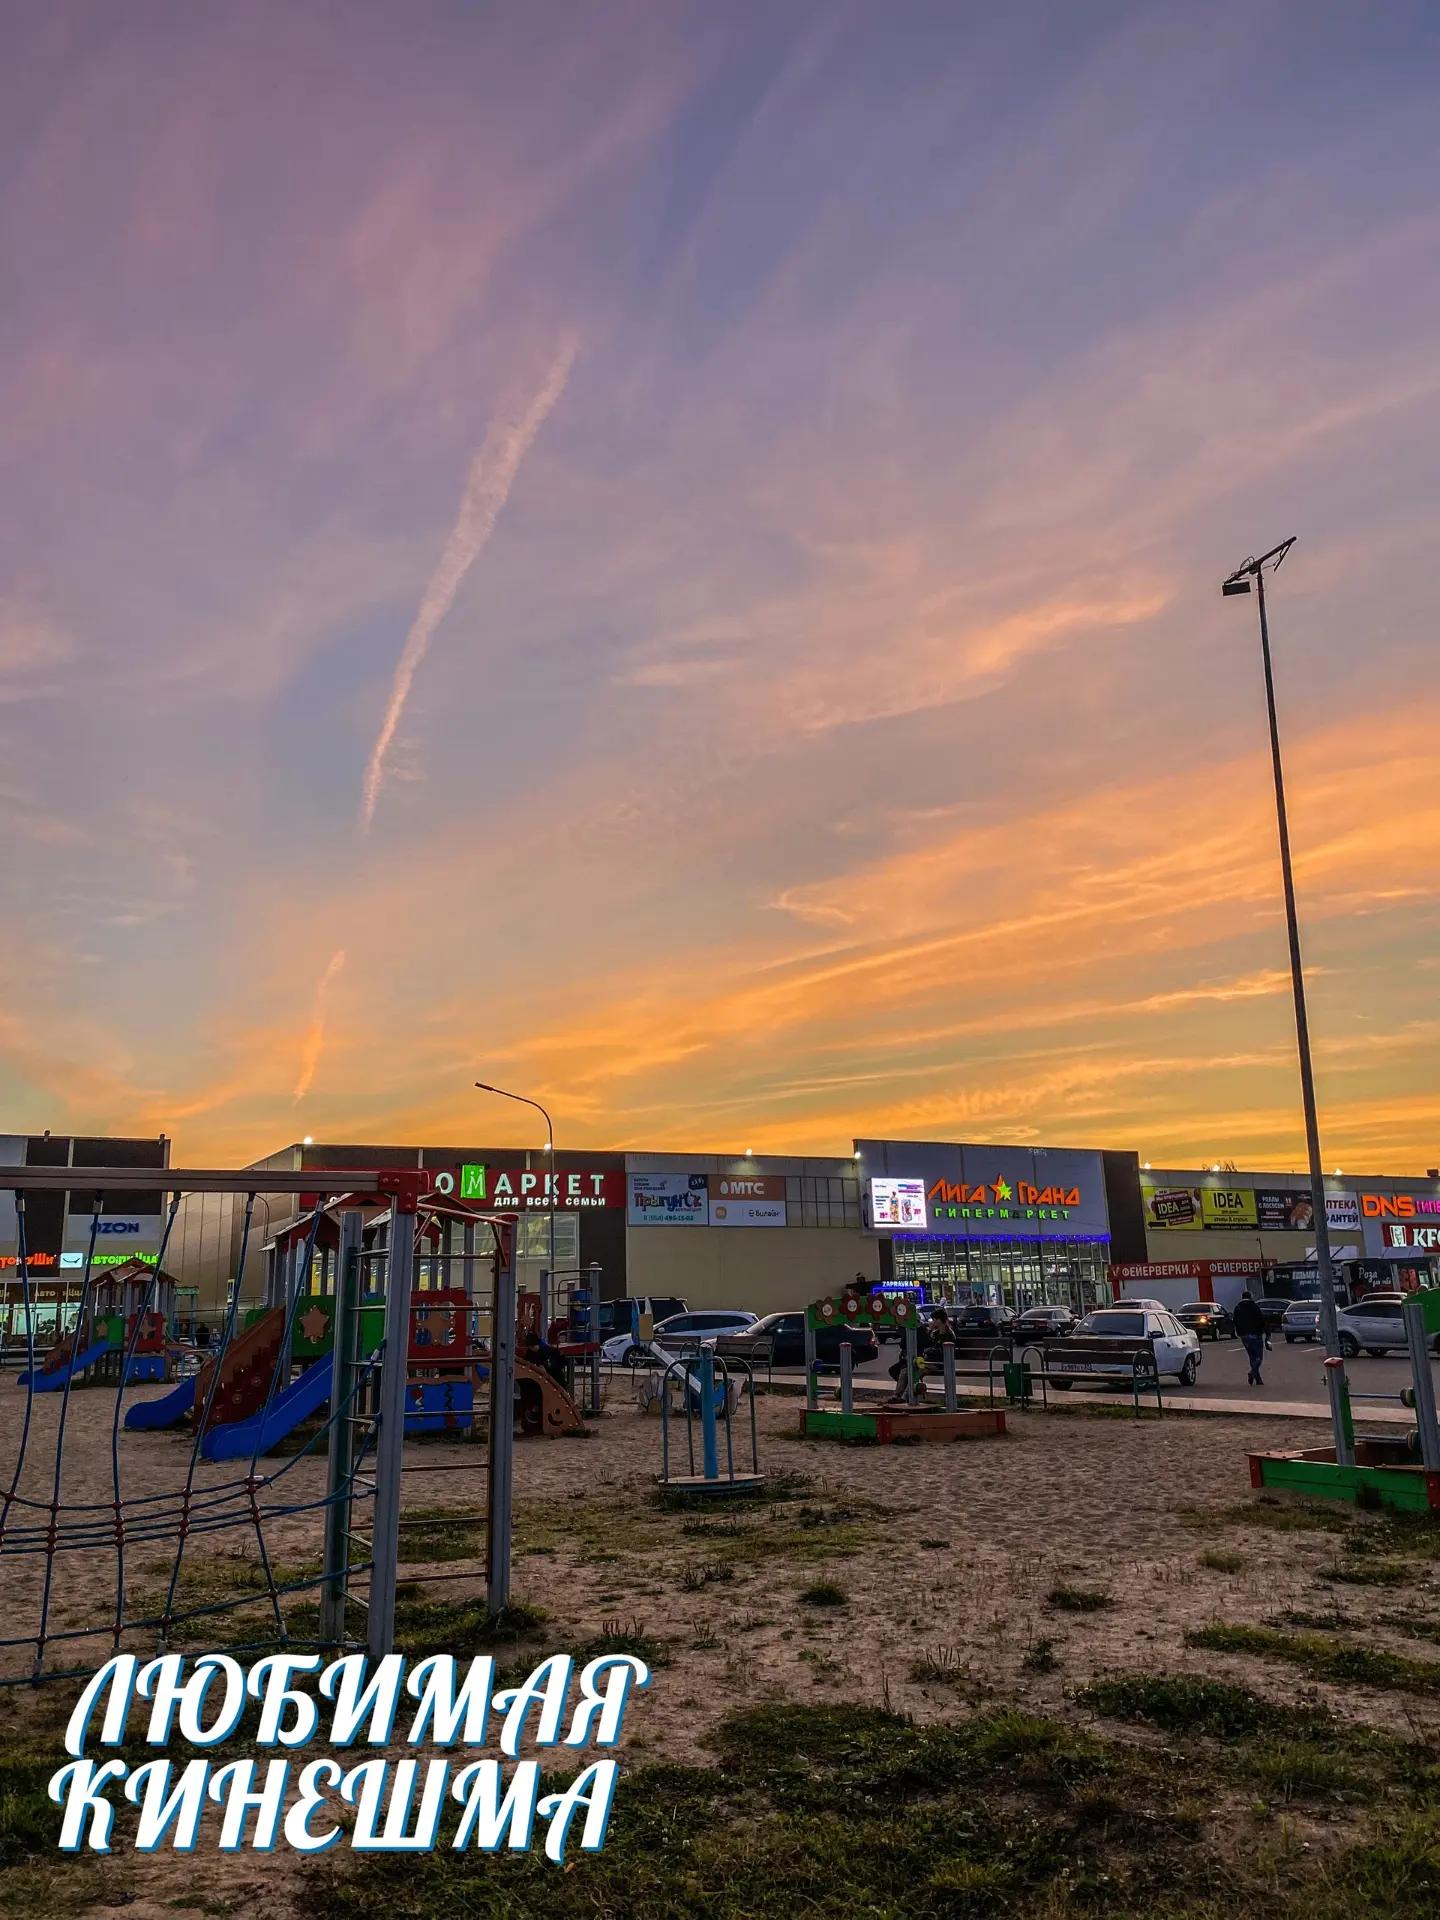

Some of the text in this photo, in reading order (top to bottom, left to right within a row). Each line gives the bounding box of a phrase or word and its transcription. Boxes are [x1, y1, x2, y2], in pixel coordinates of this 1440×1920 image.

[730, 1181, 765, 1195] МТС
[494, 1195, 606, 1207] для всей семьи
[1213, 1192, 1244, 1209] IDEA
[1325, 1199, 1357, 1209] ПТЕКА
[1361, 1194, 1416, 1217] DNS
[934, 1207, 1070, 1220] ГИПЕРМАРКЕТ
[1157, 1201, 1180, 1215] IDEA
[1330, 1212, 1359, 1223] АНТЕЙ
[1412, 1228, 1440, 1248] KF
[1121, 1263, 1189, 1277] ФЕЙЕРВЕРКИ
[1358, 1267, 1378, 1283] Роза
